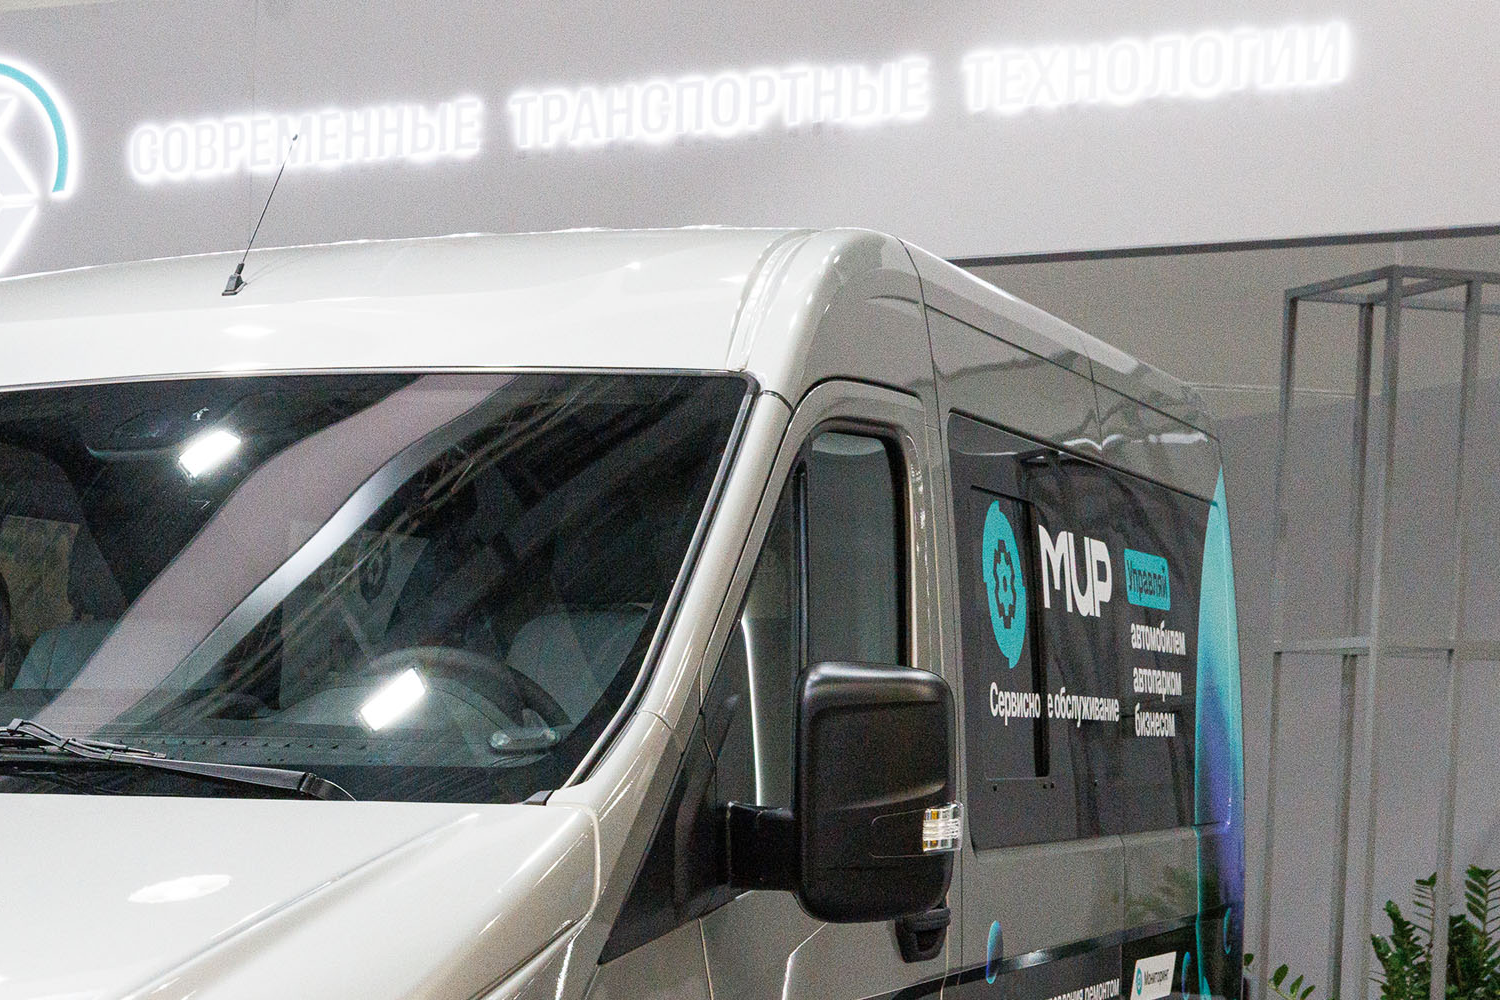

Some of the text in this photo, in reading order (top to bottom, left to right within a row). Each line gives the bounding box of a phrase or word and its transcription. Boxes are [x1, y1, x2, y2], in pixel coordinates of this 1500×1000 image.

[130, 21, 1349, 179] СОВРЕМЕННЫЕ ТРАНСПОРТНЫЕ ТЕХНОЛОГИИ
[1126, 558, 1169, 602] Управляй
[1130, 620, 1187, 655] автомобилем
[1132, 667, 1182, 702] автопарком
[1054, 686, 1120, 727] обслуживание
[1134, 703, 1177, 737] бизнесом
